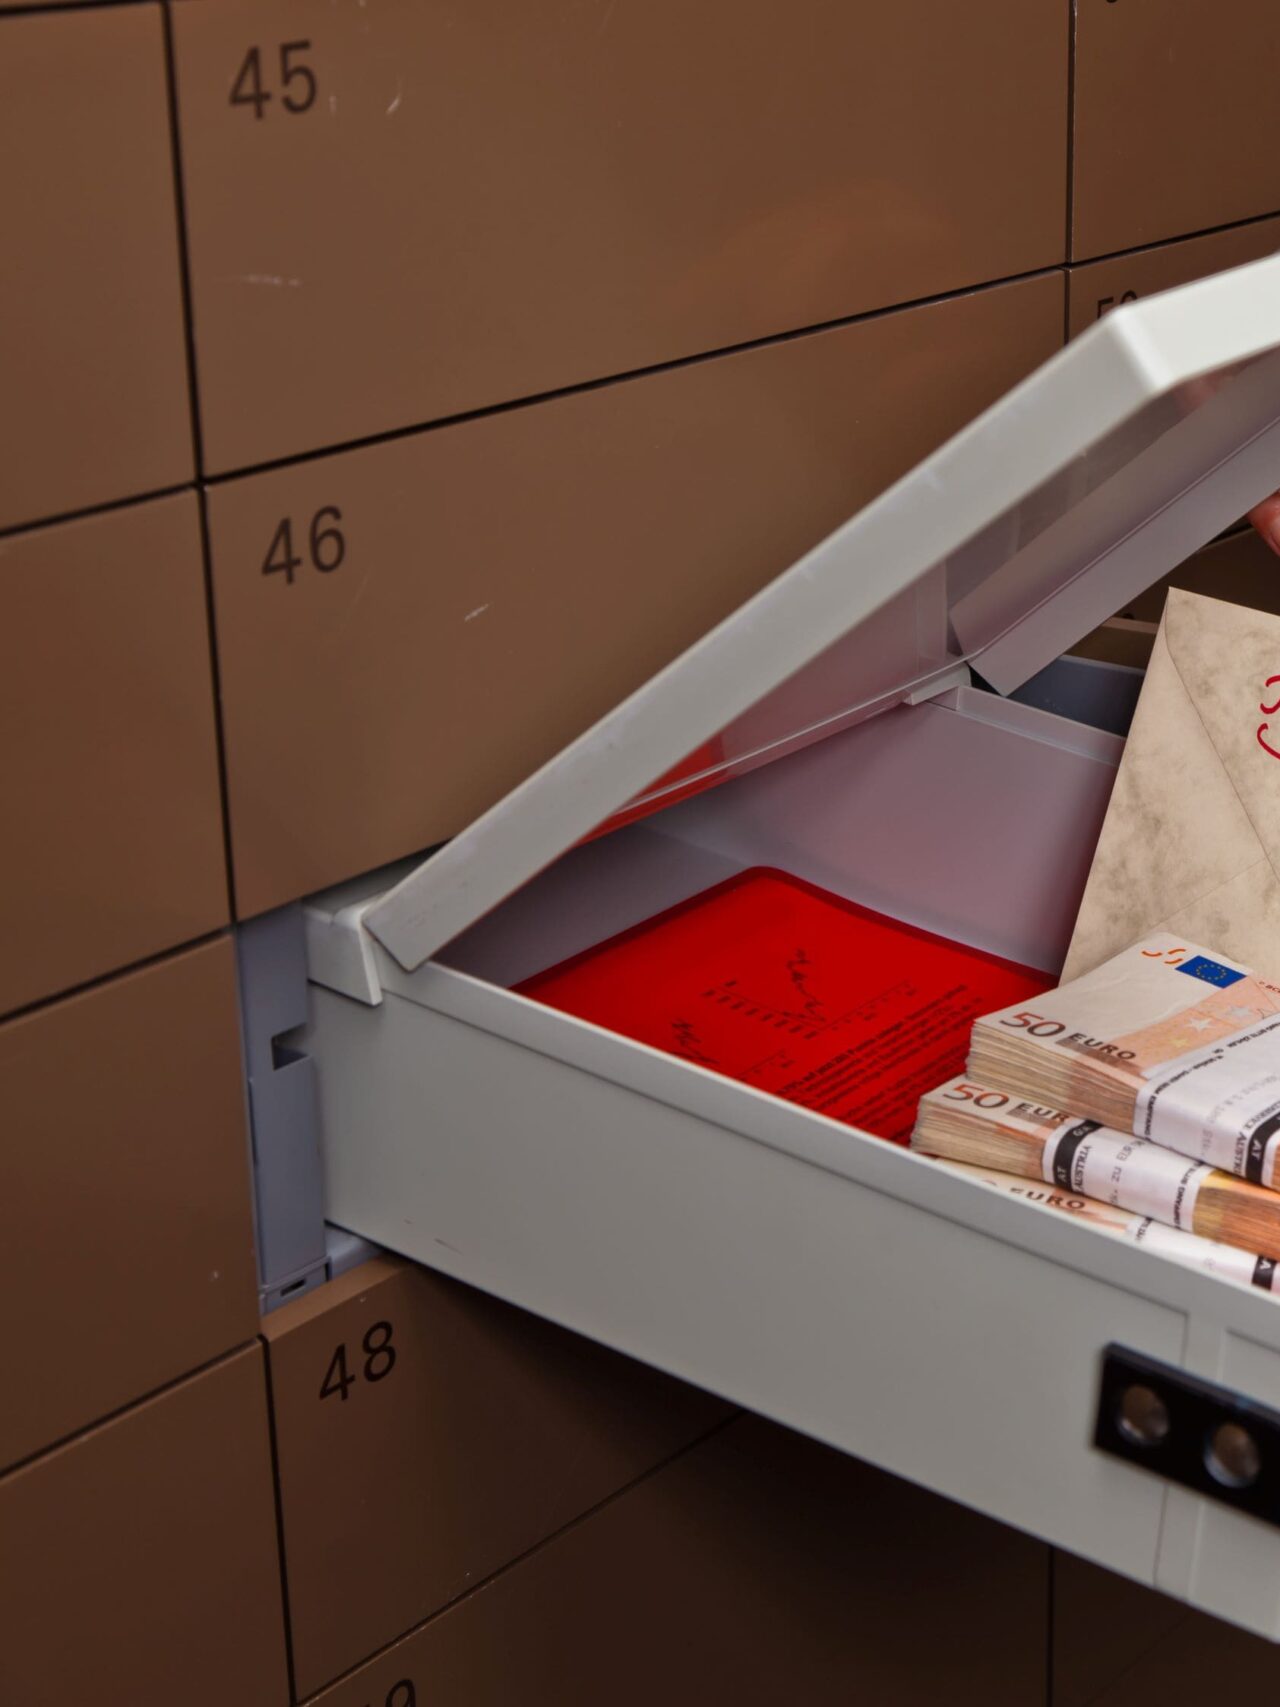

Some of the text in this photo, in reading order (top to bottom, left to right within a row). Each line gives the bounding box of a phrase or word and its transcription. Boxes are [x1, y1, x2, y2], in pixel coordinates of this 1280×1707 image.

[228, 40, 318, 121] 45
[261, 505, 347, 586] 46
[999, 1011, 1137, 1060] 50 EURO
[942, 1084, 1070, 1122] 50 EUR
[1233, 1131, 1248, 1175] AUSTRI
[1250, 1139, 1262, 1161] AT
[318, 1320, 397, 1401] 48
